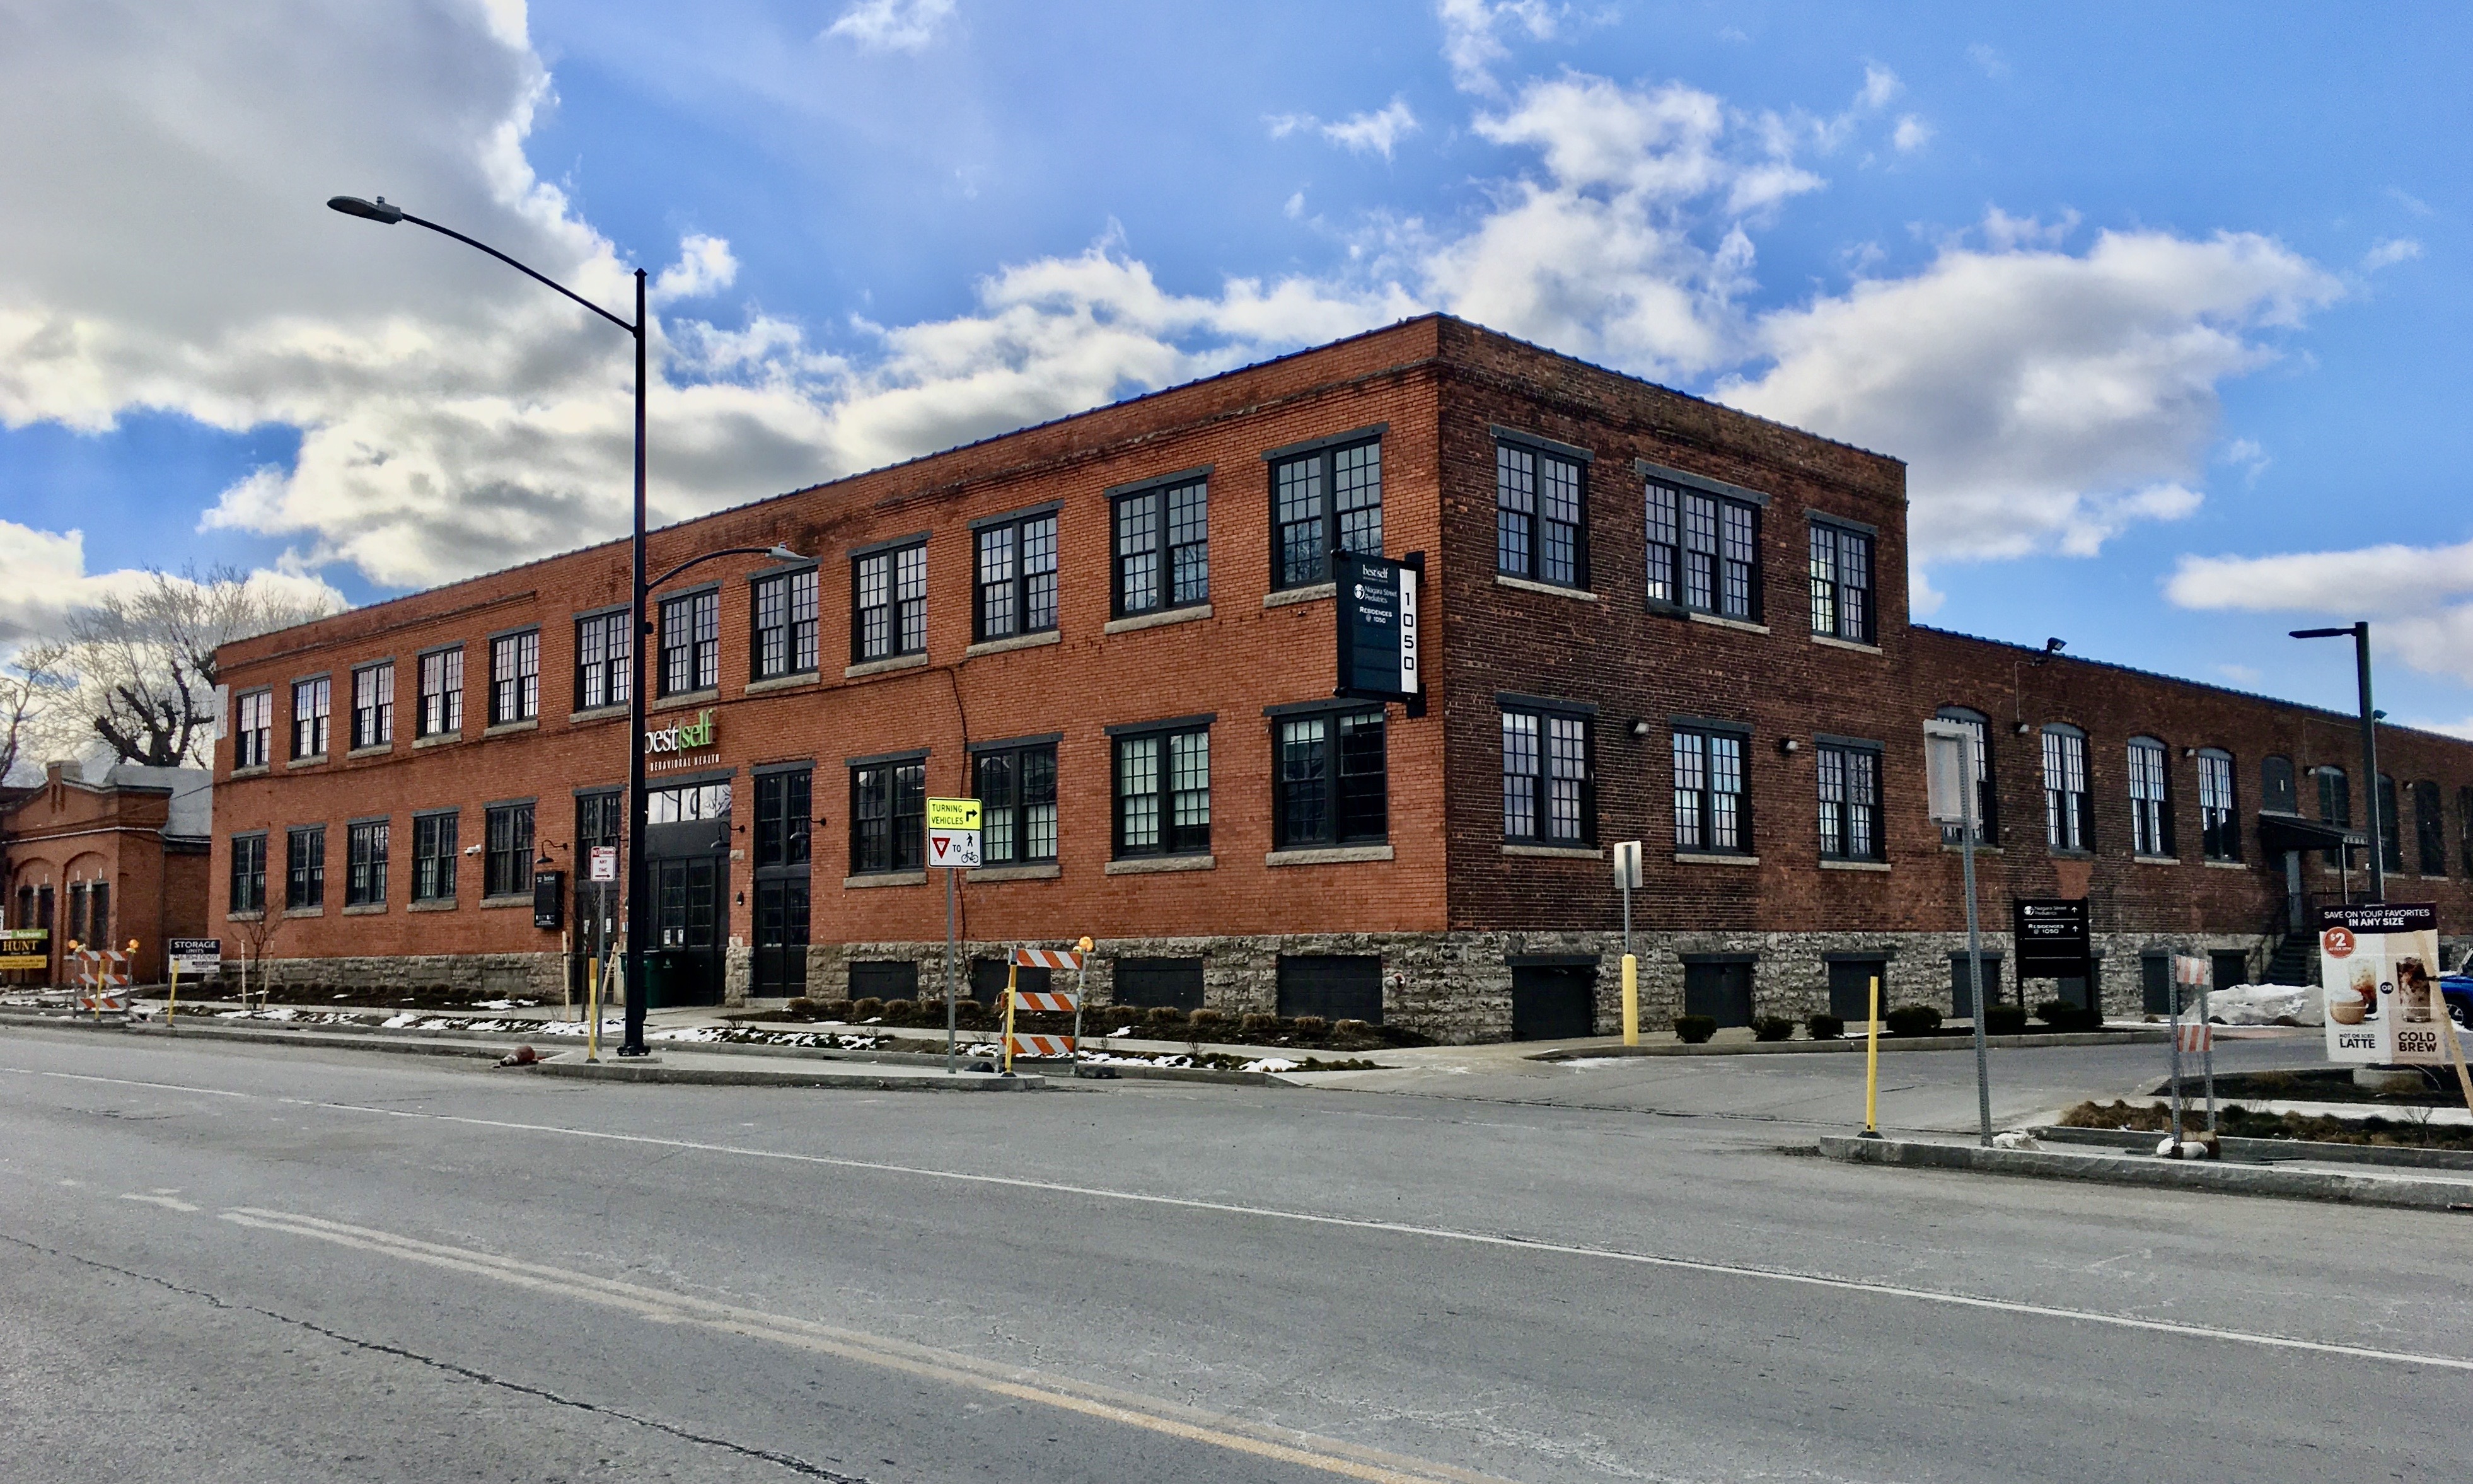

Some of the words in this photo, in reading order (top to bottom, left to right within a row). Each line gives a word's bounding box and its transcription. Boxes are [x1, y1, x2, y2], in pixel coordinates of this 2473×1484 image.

[1365, 586, 1383, 596] Niagara
[1383, 588, 1398, 597] Street
[1403, 592, 1415, 670] 1050
[694, 753, 720, 766] HEALTH
[932, 803, 963, 813] TURNING
[931, 816, 964, 825] VEHICLES
[952, 844, 961, 852] TO
[2324, 911, 2344, 919] SAVE
[2385, 909, 2430, 917] FAVORITES
[2348, 919, 2359, 927] IN
[2360, 918, 2381, 927] ANY
[2382, 917, 2404, 926] SIZE
[3, 940, 38, 951] HUNT
[2398, 1031, 2436, 1041] COLD
[2339, 1038, 2376, 1048] LATTE
[2399, 1041, 2437, 1052] BREW
